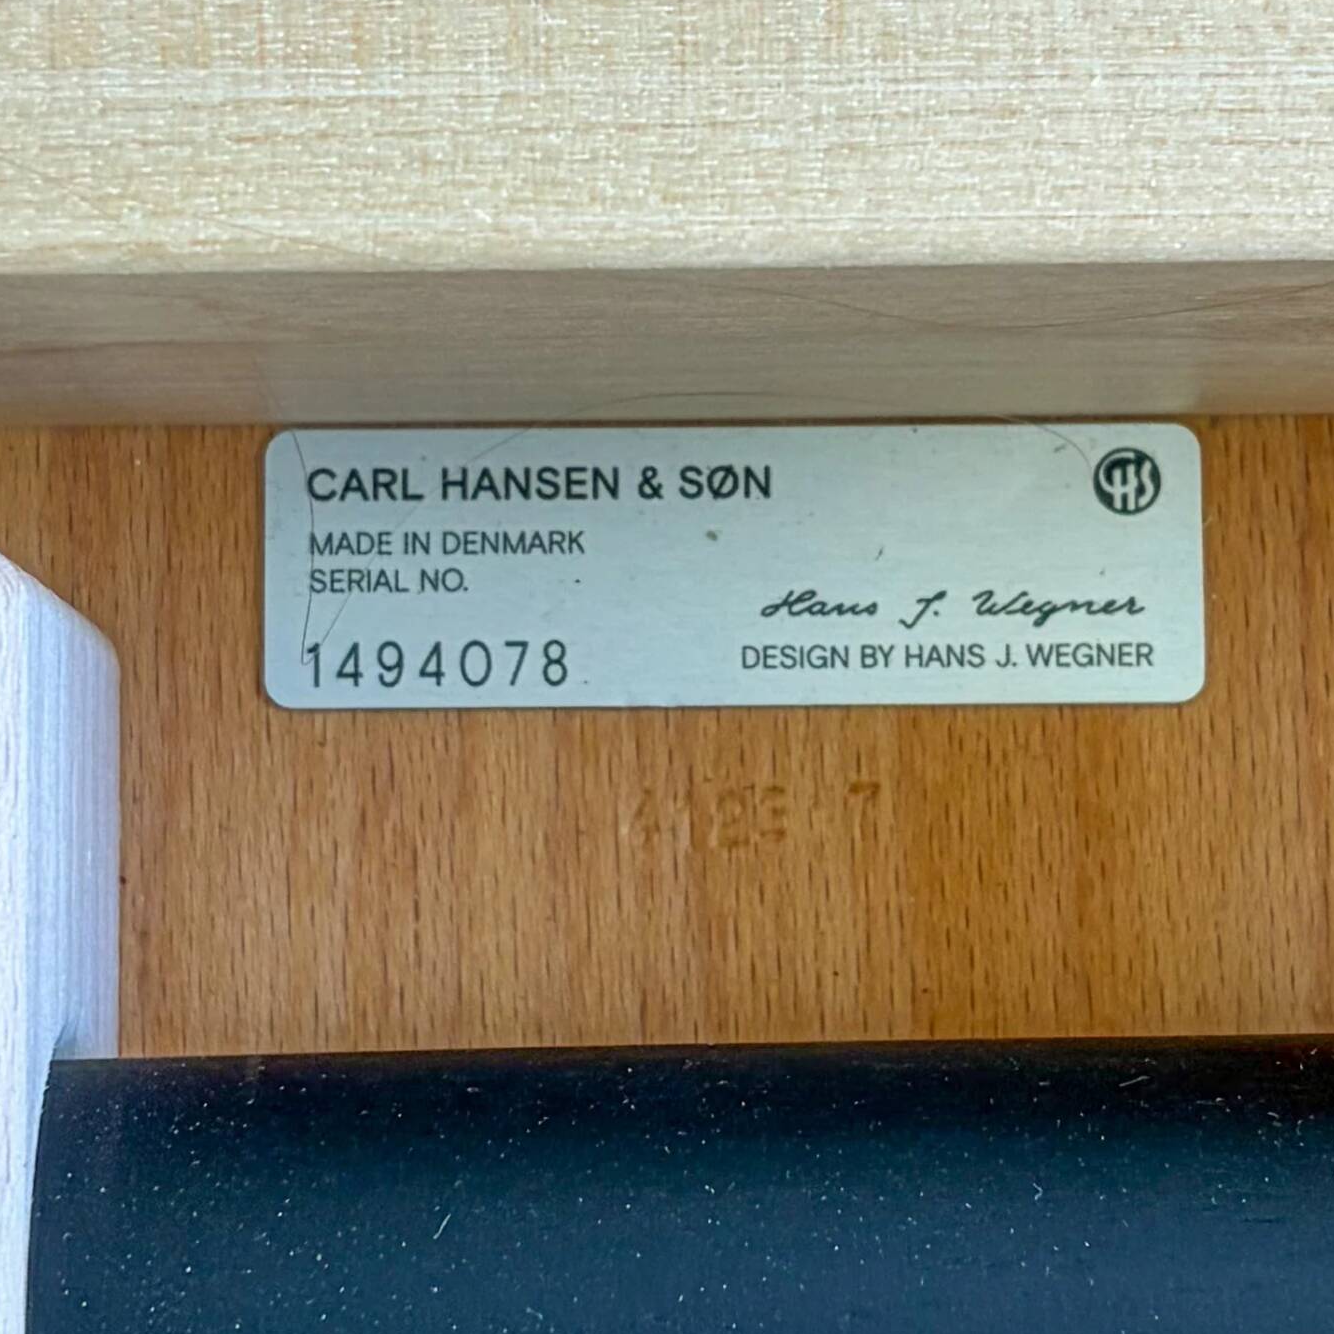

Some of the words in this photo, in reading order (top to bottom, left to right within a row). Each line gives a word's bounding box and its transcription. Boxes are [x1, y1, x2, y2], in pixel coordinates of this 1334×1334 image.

[305, 468, 425, 502] CARL
[442, 466, 619, 501] HANSEN
[638, 466, 664, 500] &
[679, 464, 771, 501] SØN
[310, 530, 392, 556] MADE
[403, 531, 430, 555] IN
[442, 530, 585, 555] DENMARK
[309, 567, 409, 593] SERIAL
[419, 567, 468, 594] NO.
[760, 589, 878, 618] Hans
[898, 590, 947, 630] J.
[972, 589, 1145, 628] Wegner
[306, 639, 568, 688] 1494078
[741, 644, 849, 670] DESIGN
[860, 644, 895, 669] BY
[905, 643, 986, 668] HANS
[995, 644, 1017, 668] J.
[1025, 642, 1154, 668] WEGNER
